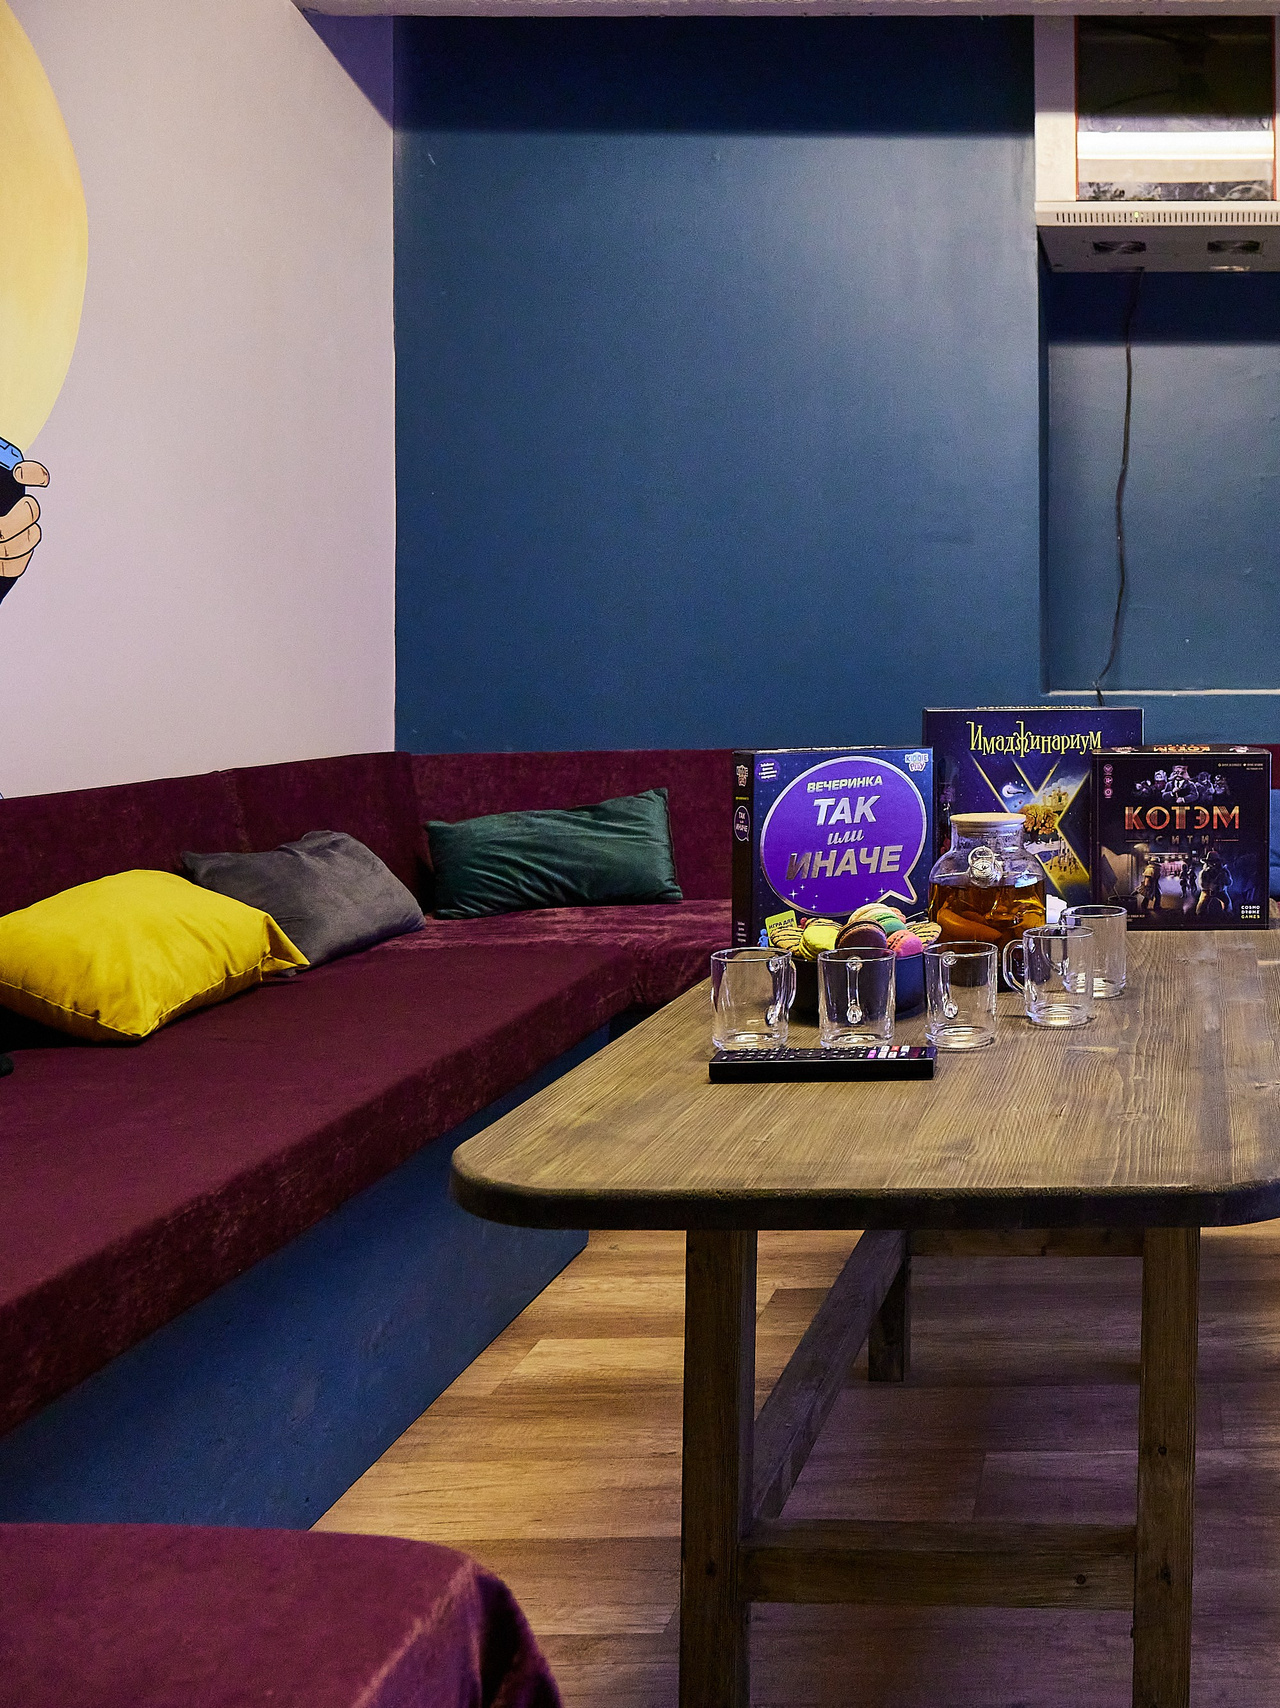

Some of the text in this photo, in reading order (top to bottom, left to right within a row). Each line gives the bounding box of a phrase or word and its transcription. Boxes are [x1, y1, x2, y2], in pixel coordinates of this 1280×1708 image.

[966, 720, 1102, 758] Имаджинариум
[905, 754, 928, 763] KIDDIE
[806, 775, 883, 793] ВЕЧЕРИНКА
[813, 795, 881, 826] ТАК
[1124, 805, 1240, 830] КОТЭМ
[827, 829, 865, 845] или
[1155, 834, 1211, 845] СИТИ
[785, 845, 904, 880] ИНАЧЕ
